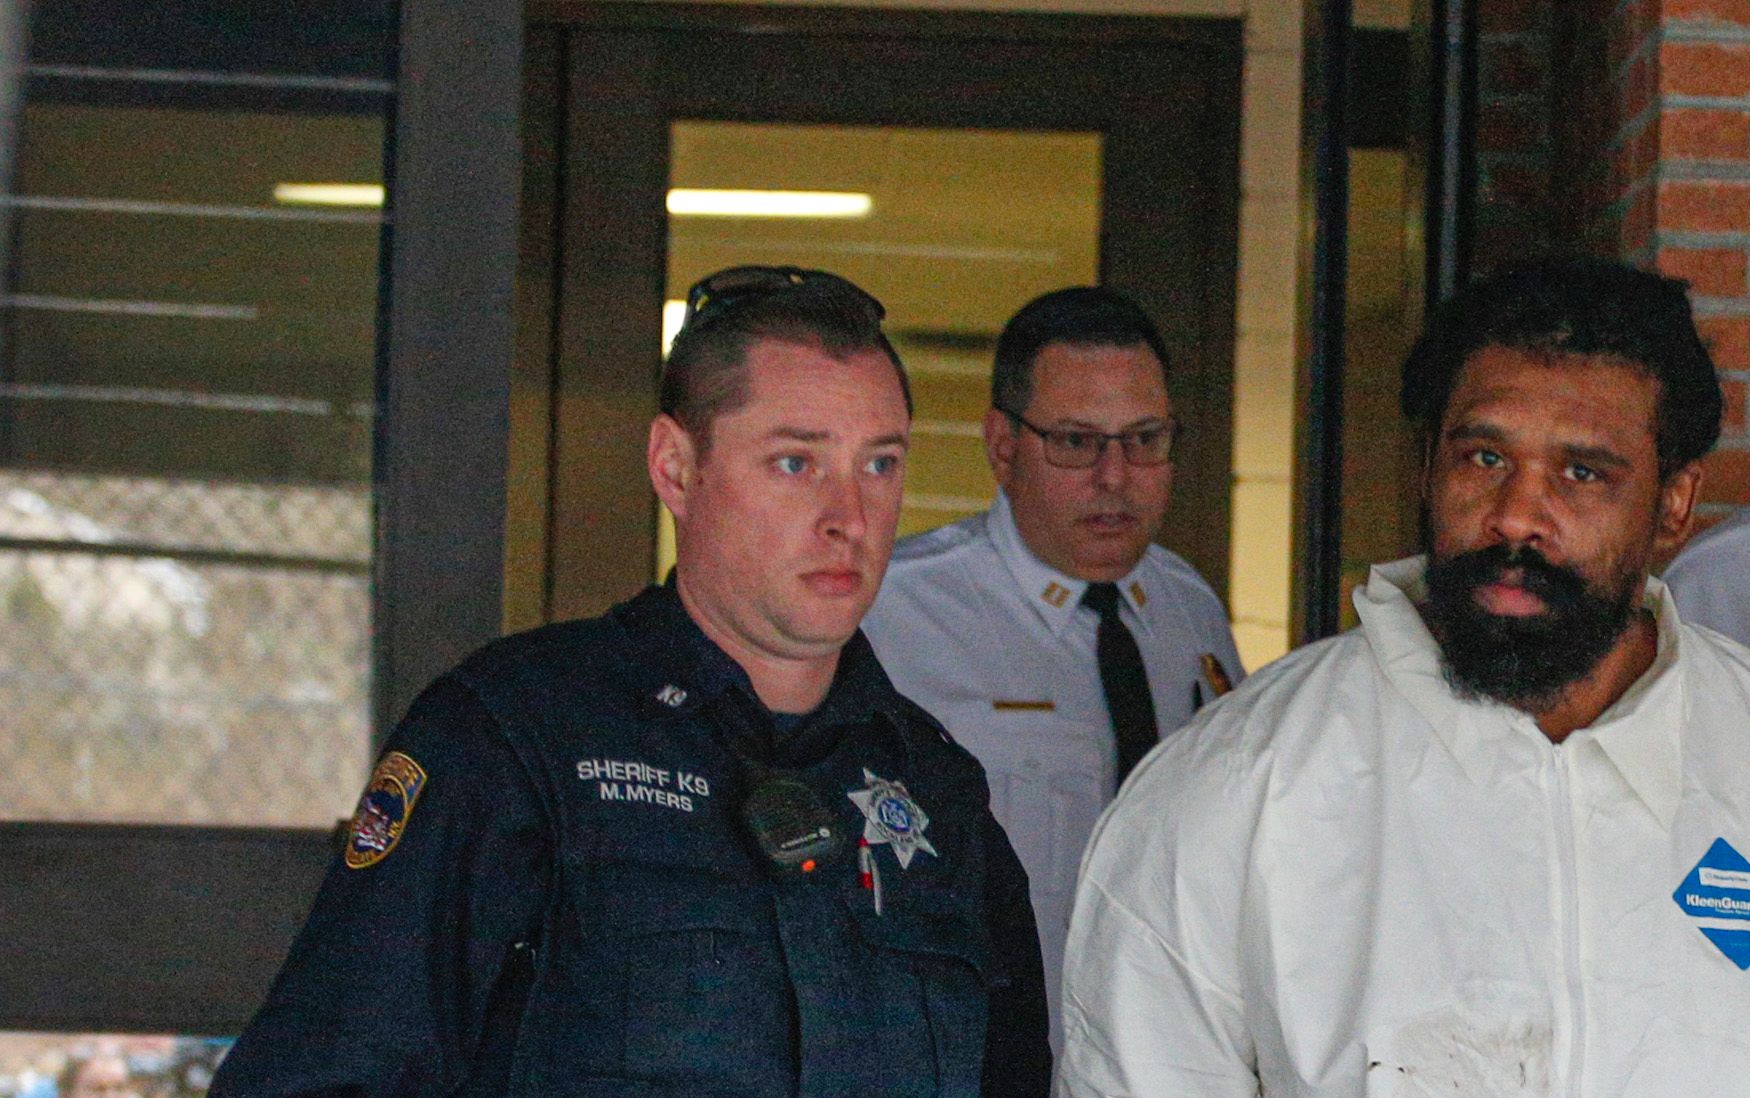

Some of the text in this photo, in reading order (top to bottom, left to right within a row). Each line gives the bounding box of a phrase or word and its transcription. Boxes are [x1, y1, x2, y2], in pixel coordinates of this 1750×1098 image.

[576, 758, 710, 796] SHERIFF K9
[600, 782, 694, 812] M.MYERS
